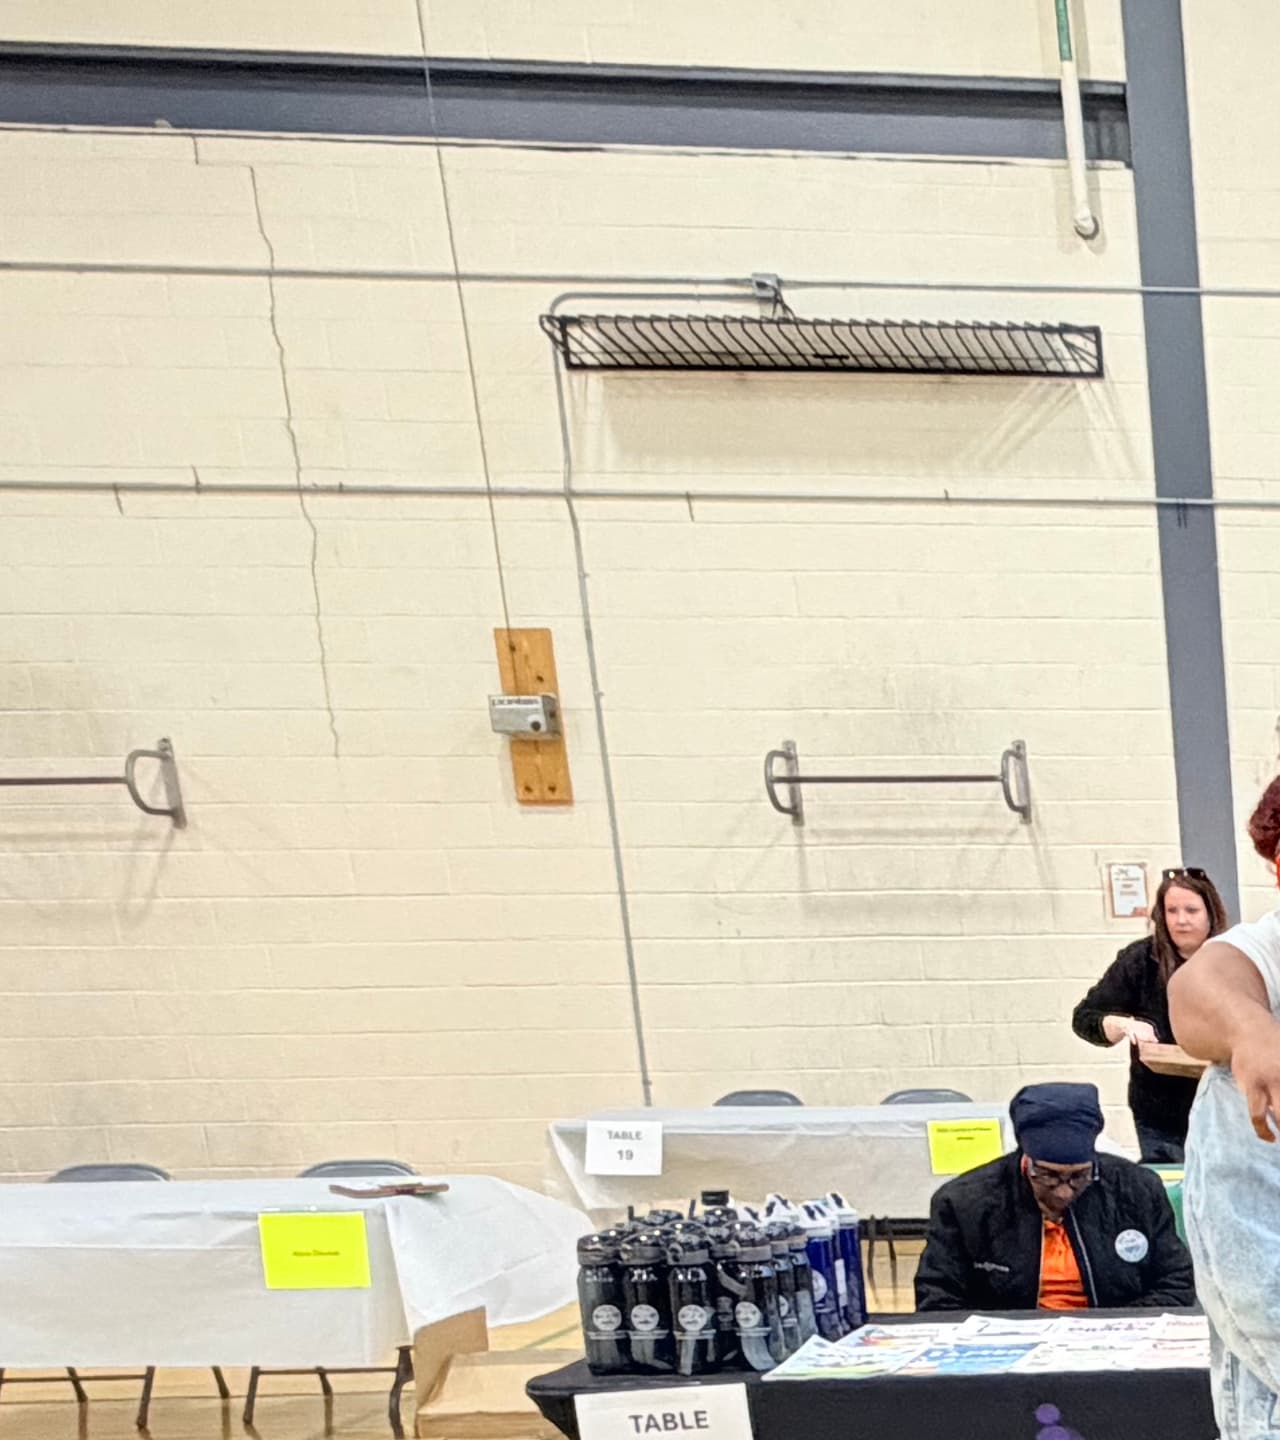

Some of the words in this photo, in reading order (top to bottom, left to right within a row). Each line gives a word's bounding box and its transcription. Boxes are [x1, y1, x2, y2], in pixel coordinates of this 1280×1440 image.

[607, 1130, 643, 1141] TABLE
[616, 1149, 634, 1161] 19
[629, 1410, 709, 1435] TABLE
